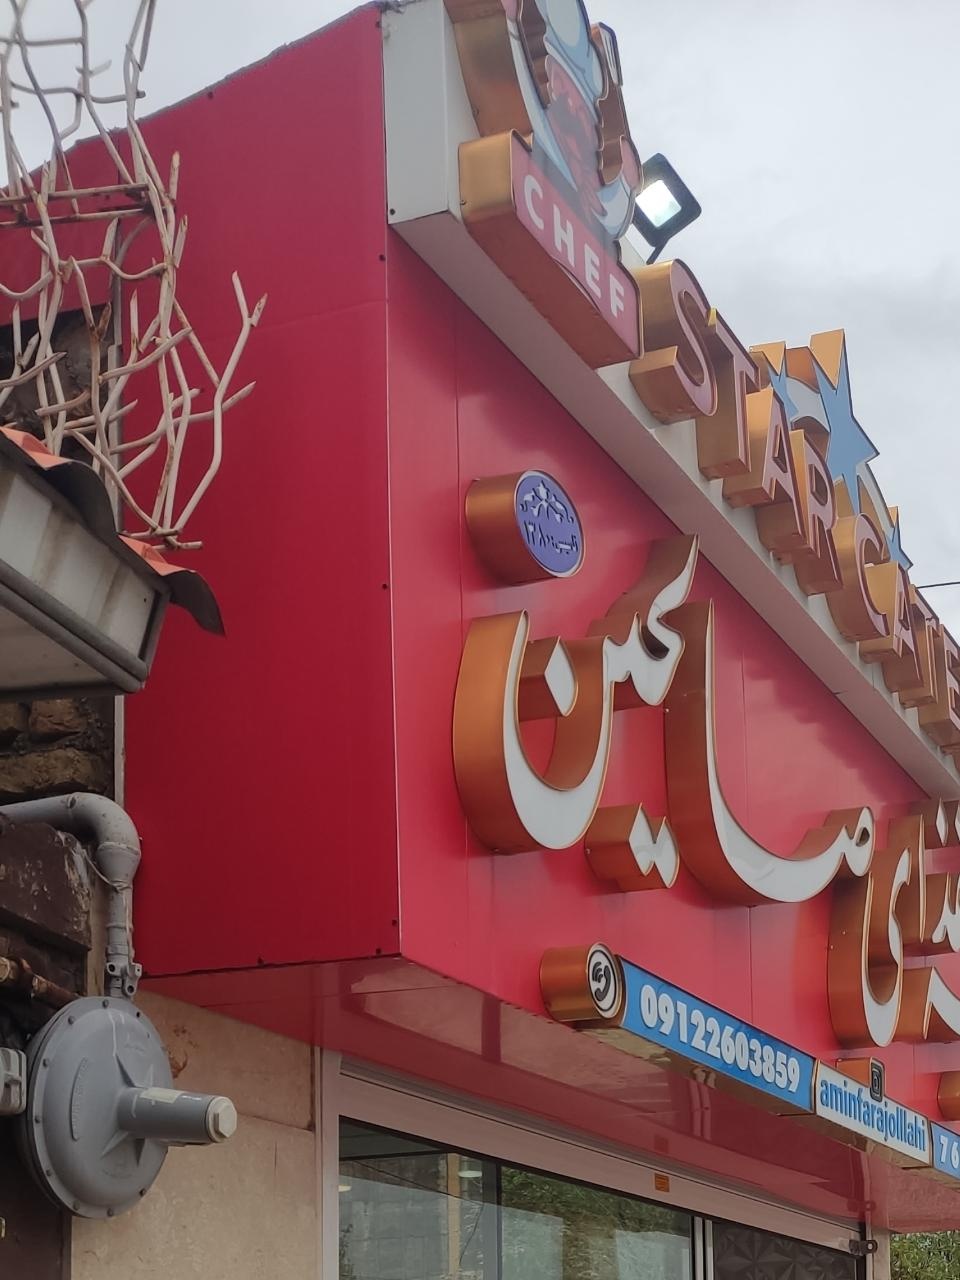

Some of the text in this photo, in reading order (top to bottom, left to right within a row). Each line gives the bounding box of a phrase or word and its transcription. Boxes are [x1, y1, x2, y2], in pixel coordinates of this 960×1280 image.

[523, 174, 625, 318] CHEF
[668, 258, 843, 590] STAR
[502, 533, 875, 902] صالحین
[640, 984, 801, 1093] 09122603859
